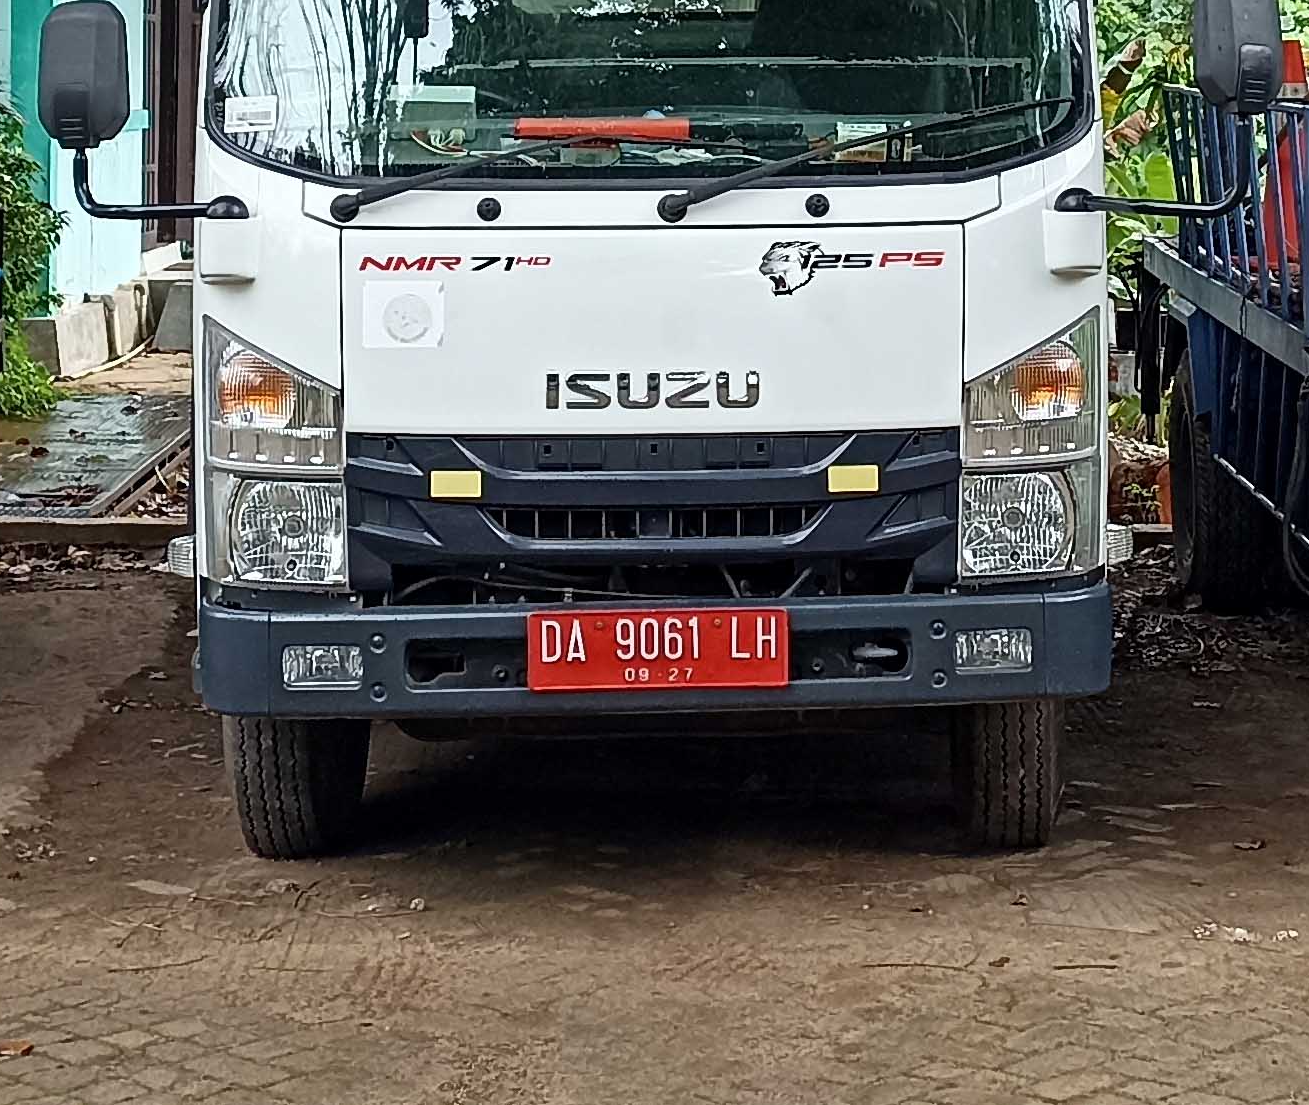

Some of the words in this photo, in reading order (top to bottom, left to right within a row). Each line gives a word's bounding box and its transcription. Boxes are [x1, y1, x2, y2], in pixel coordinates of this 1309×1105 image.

[359, 256, 462, 271] NMR
[878, 251, 946, 268] PS
[545, 371, 761, 410] ISUZU
[541, 618, 587, 663] DA
[616, 615, 700, 661] 9061
[730, 615, 778, 659] LH
